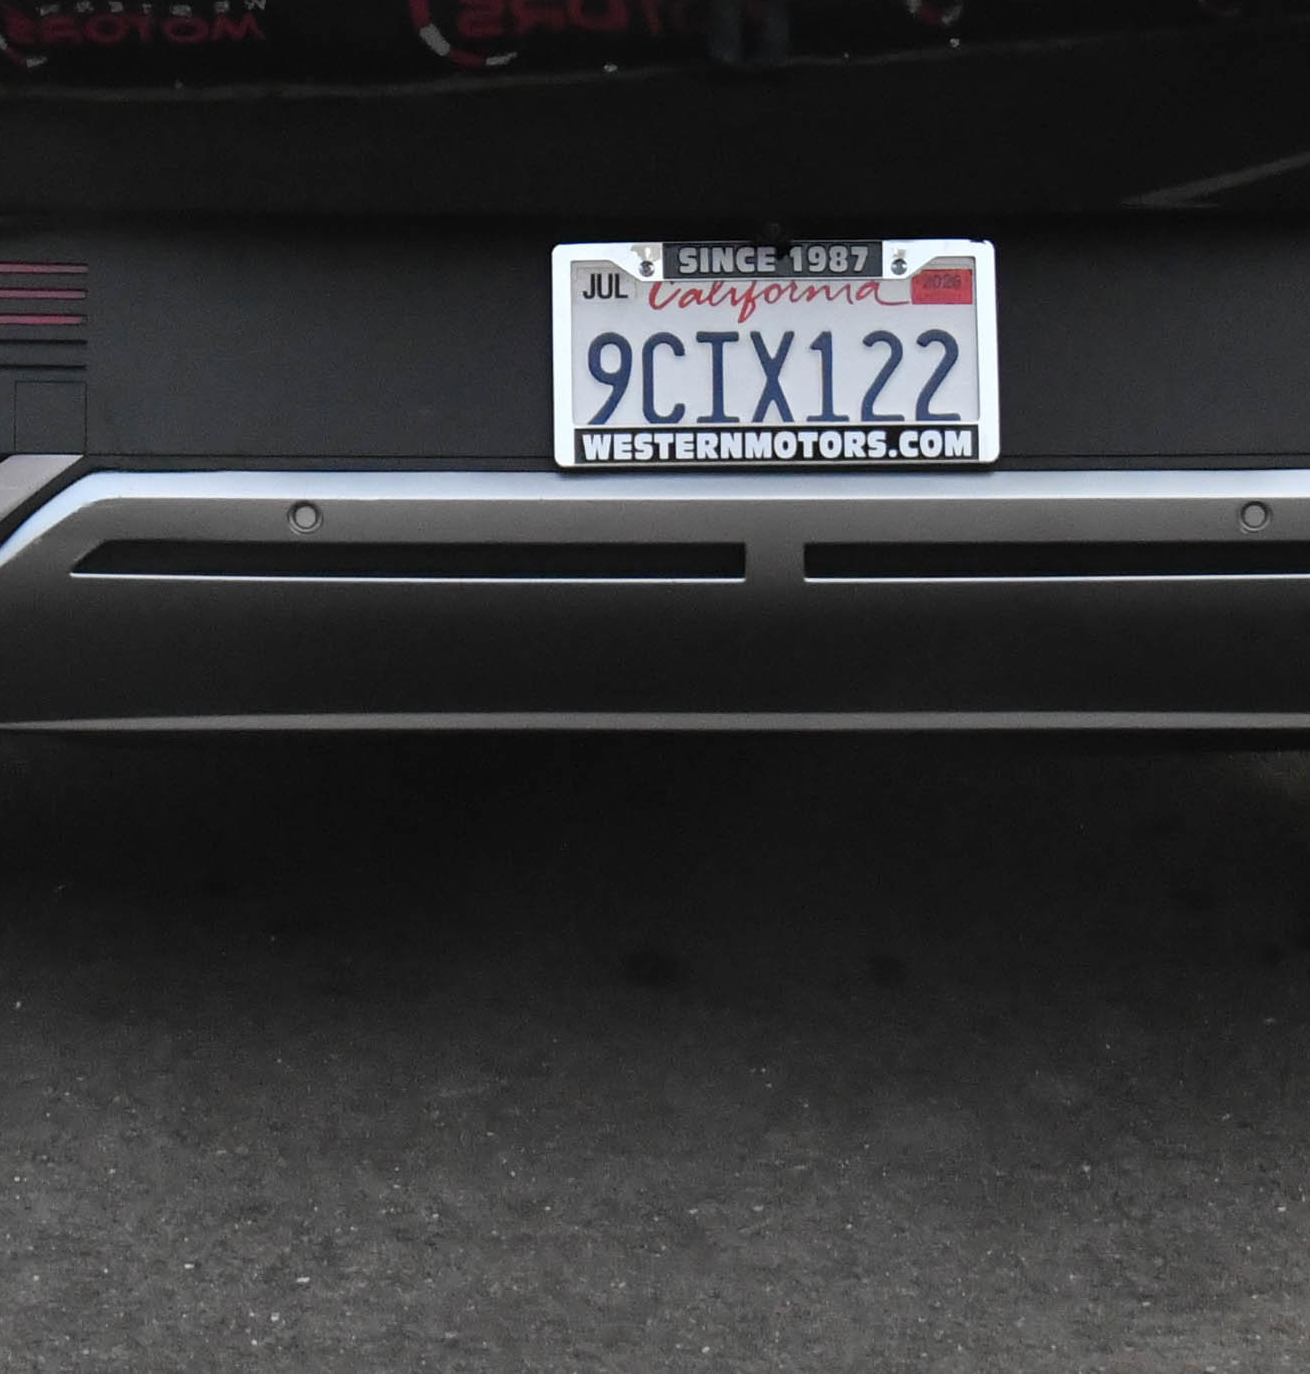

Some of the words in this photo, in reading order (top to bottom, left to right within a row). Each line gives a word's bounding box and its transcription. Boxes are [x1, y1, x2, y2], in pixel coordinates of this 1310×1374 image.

[678, 246, 777, 274] SINCE
[790, 245, 869, 273] 1987
[582, 272, 629, 300] JUL
[648, 279, 911, 323] California
[587, 328, 961, 425] 9CIX122
[582, 429, 973, 462] WESTERNMOTORS.COM
